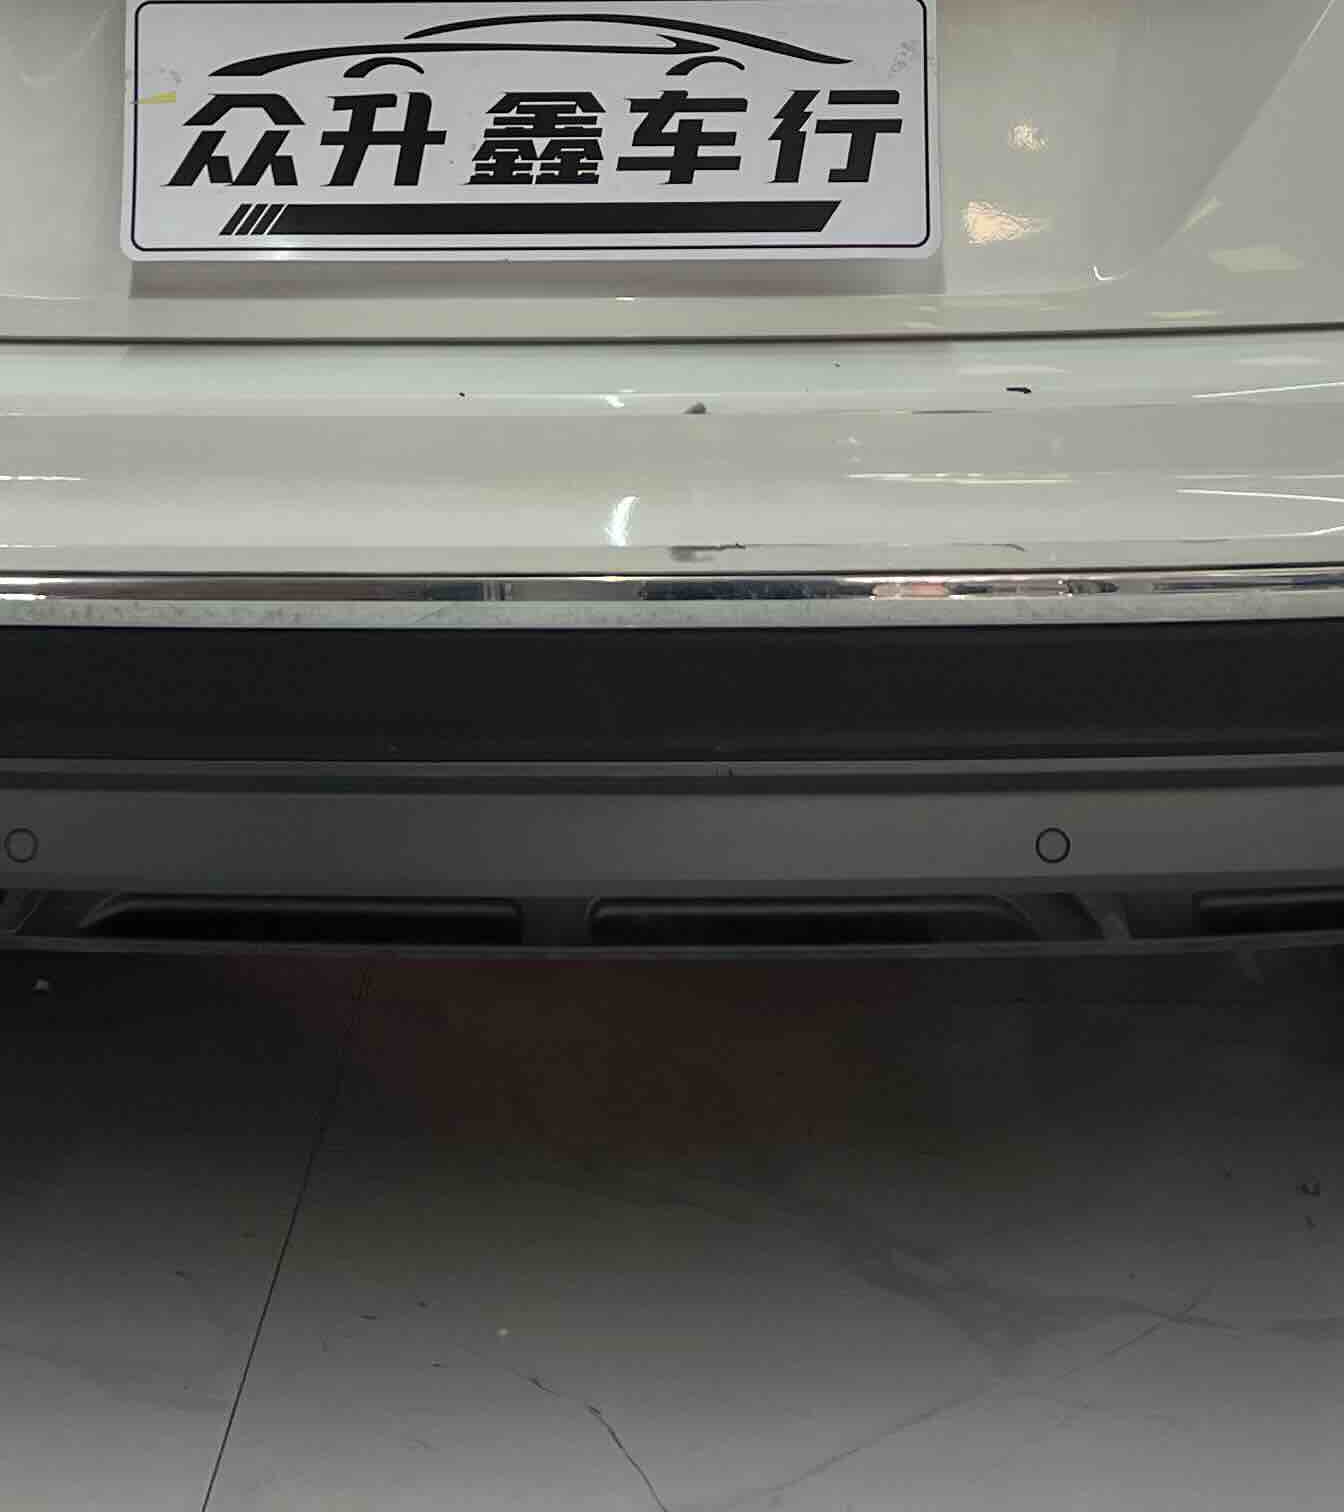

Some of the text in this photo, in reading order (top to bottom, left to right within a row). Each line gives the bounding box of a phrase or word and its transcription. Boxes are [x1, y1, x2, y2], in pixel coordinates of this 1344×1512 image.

[160, 88, 903, 187] 众升鑫车行
